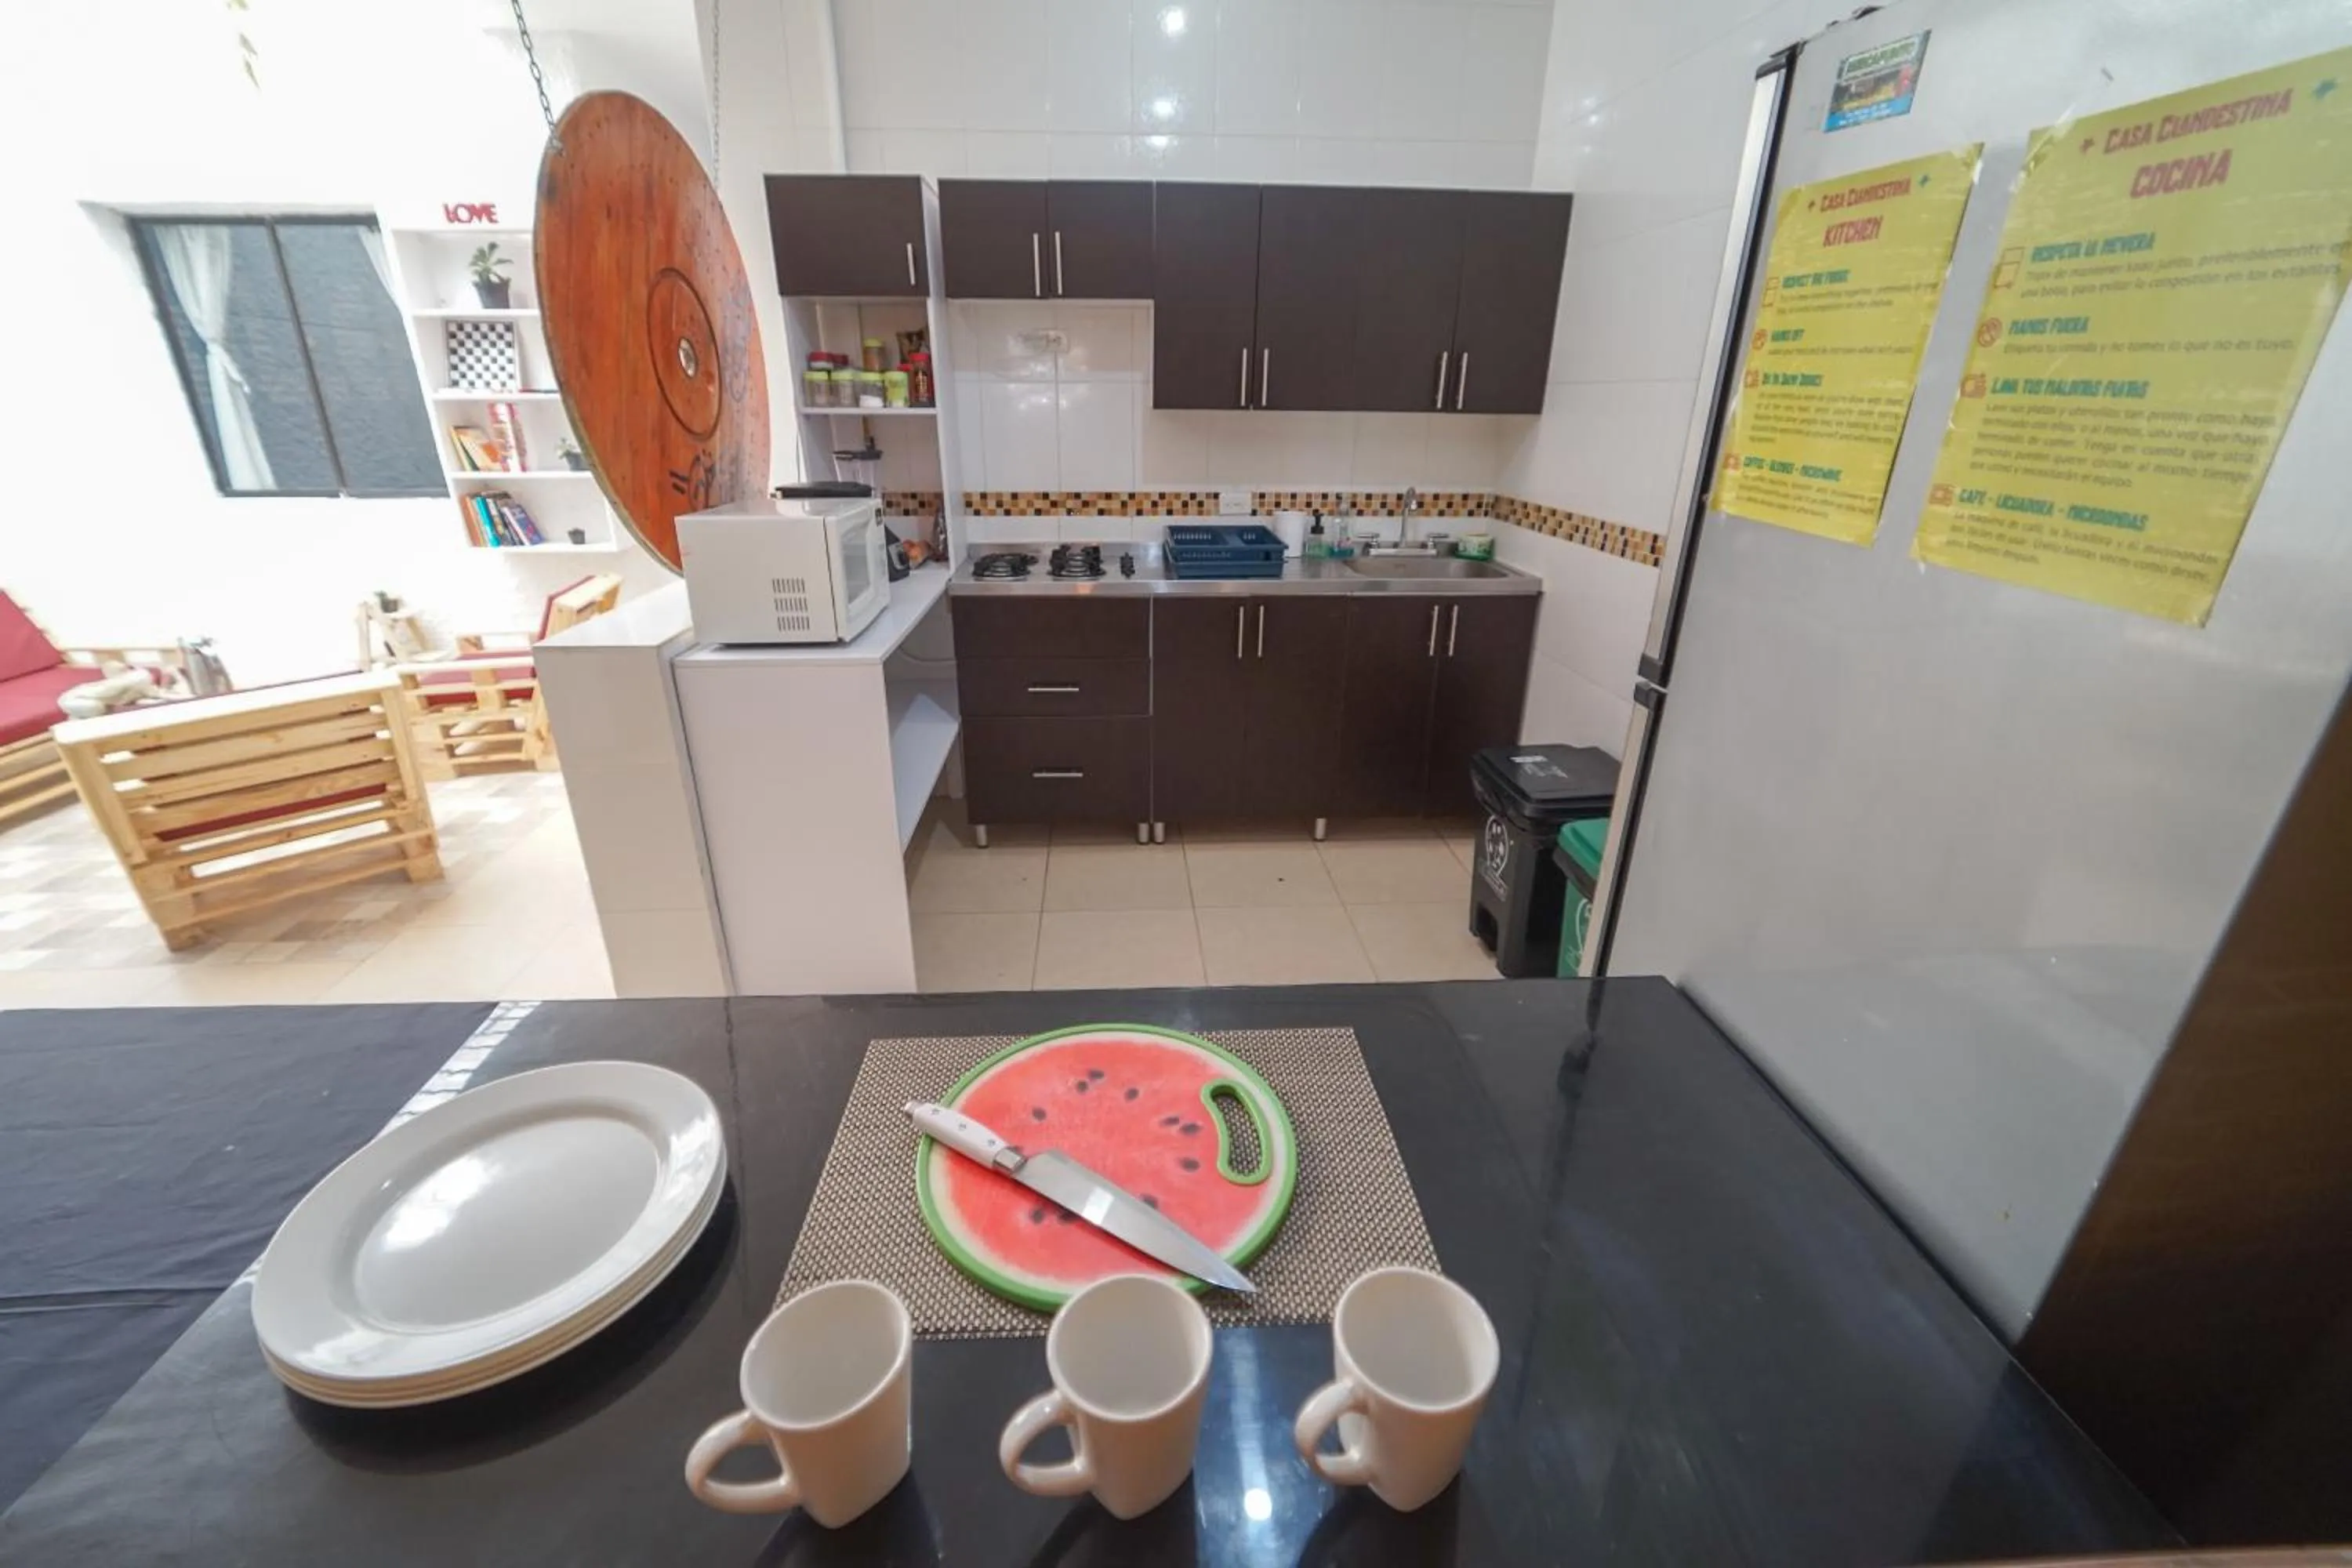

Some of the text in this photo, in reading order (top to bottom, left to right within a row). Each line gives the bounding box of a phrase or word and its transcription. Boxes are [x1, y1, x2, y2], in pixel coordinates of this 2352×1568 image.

[2103, 88, 2294, 154] CASA CLANDESTINA
[2129, 148, 2233, 199] COCINA
[442, 202, 499, 224] LOVE
[1820, 193, 1846, 212] CASA
[1822, 216, 1883, 247] KITCHEN
